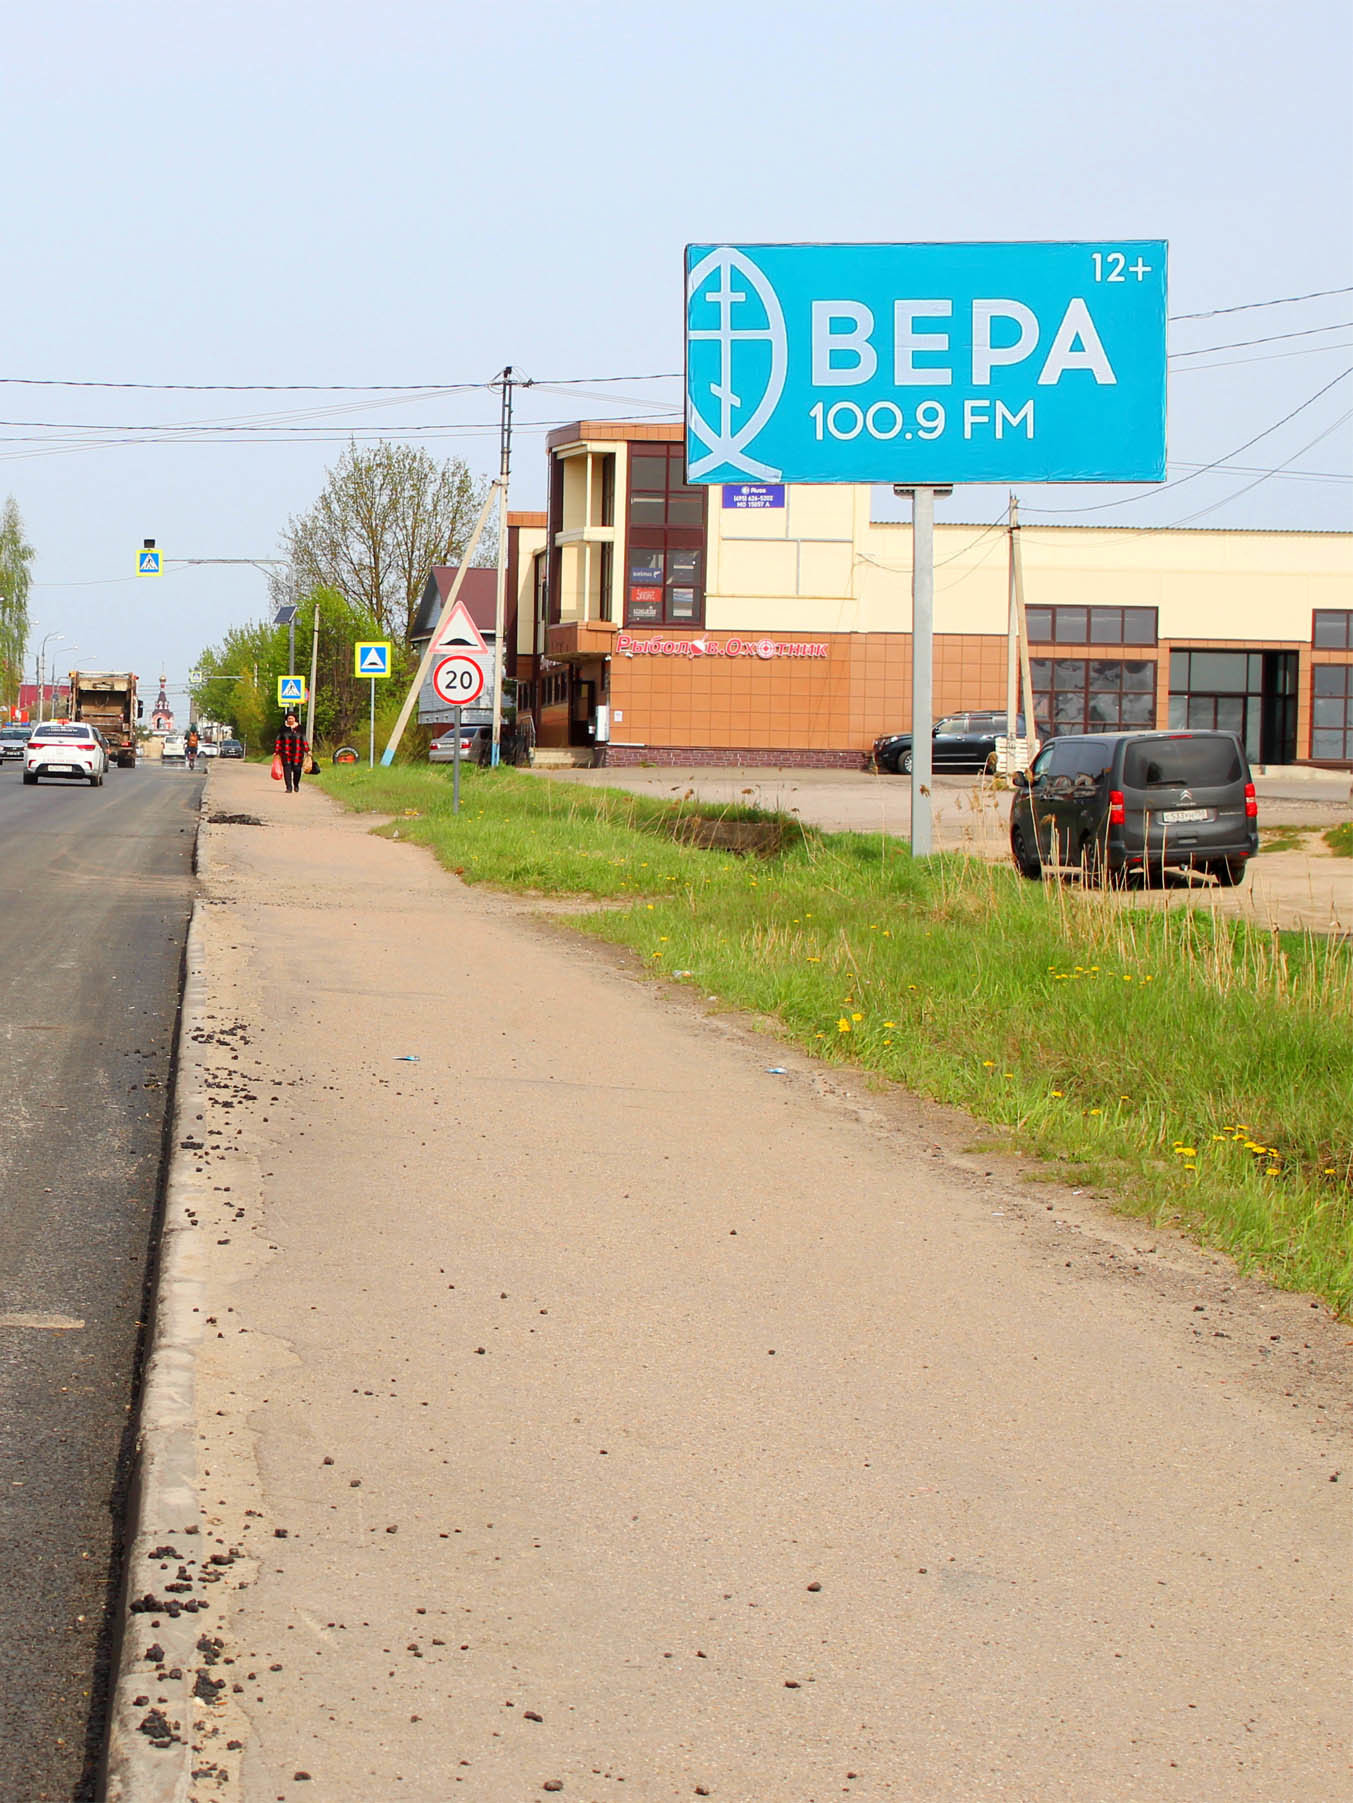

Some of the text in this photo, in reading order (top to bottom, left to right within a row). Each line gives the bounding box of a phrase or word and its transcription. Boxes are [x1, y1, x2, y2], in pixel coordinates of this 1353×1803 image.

[1091, 253, 1152, 282] 12+
[811, 298, 1117, 386] ВЕРА
[809, 399, 1035, 440] 100.9 FM
[445, 670, 472, 689] 20
